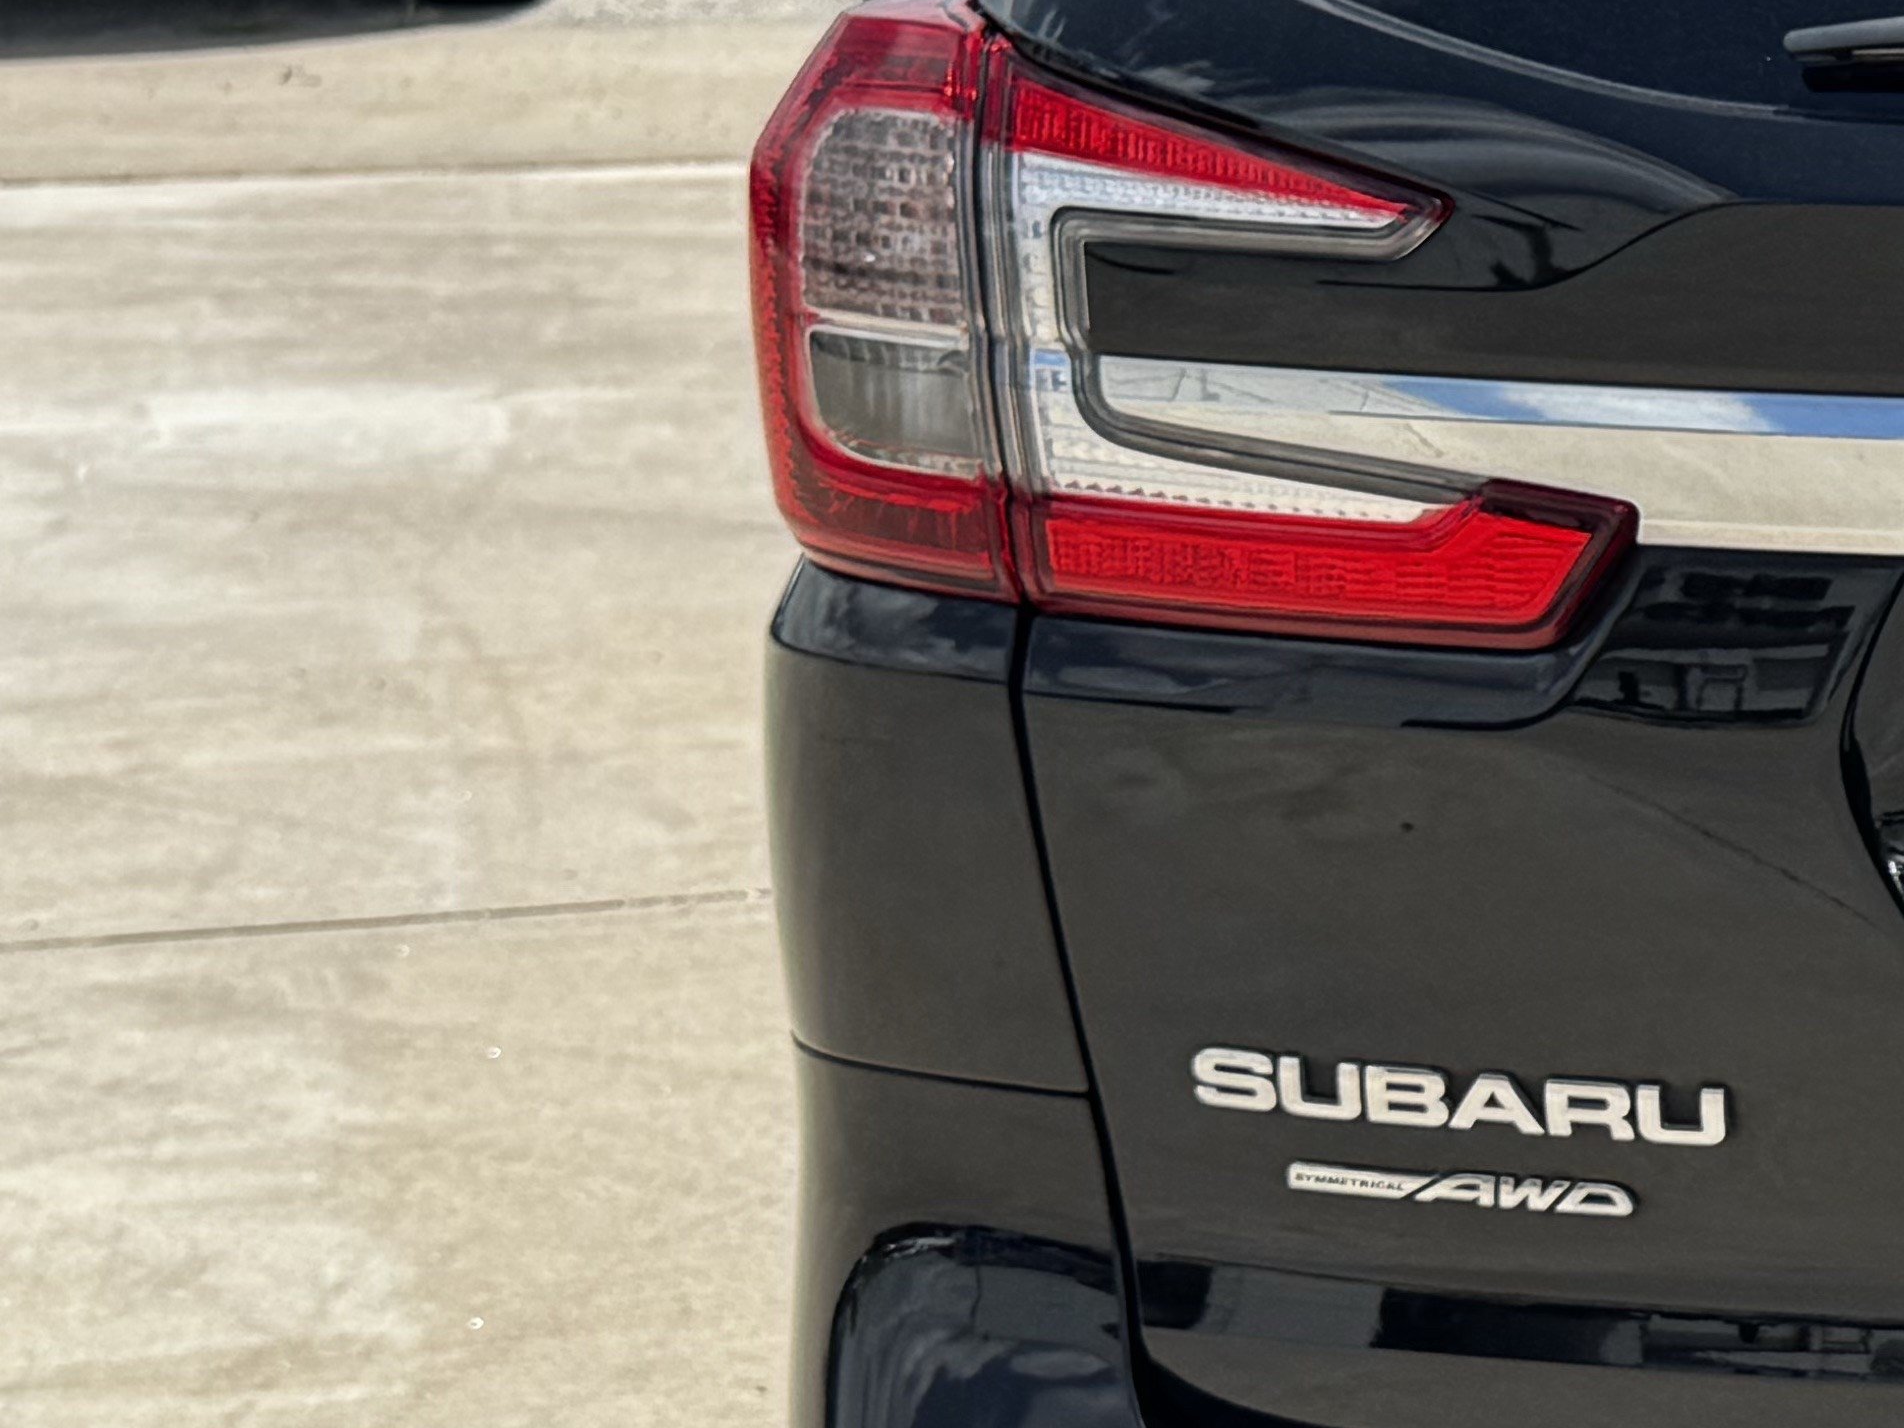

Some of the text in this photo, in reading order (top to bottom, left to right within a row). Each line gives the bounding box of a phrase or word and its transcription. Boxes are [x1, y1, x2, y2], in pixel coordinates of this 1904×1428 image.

[1191, 1047, 1727, 1146] SUBARU
[1294, 1172, 1634, 1217] SYMMETRICAL AWD
